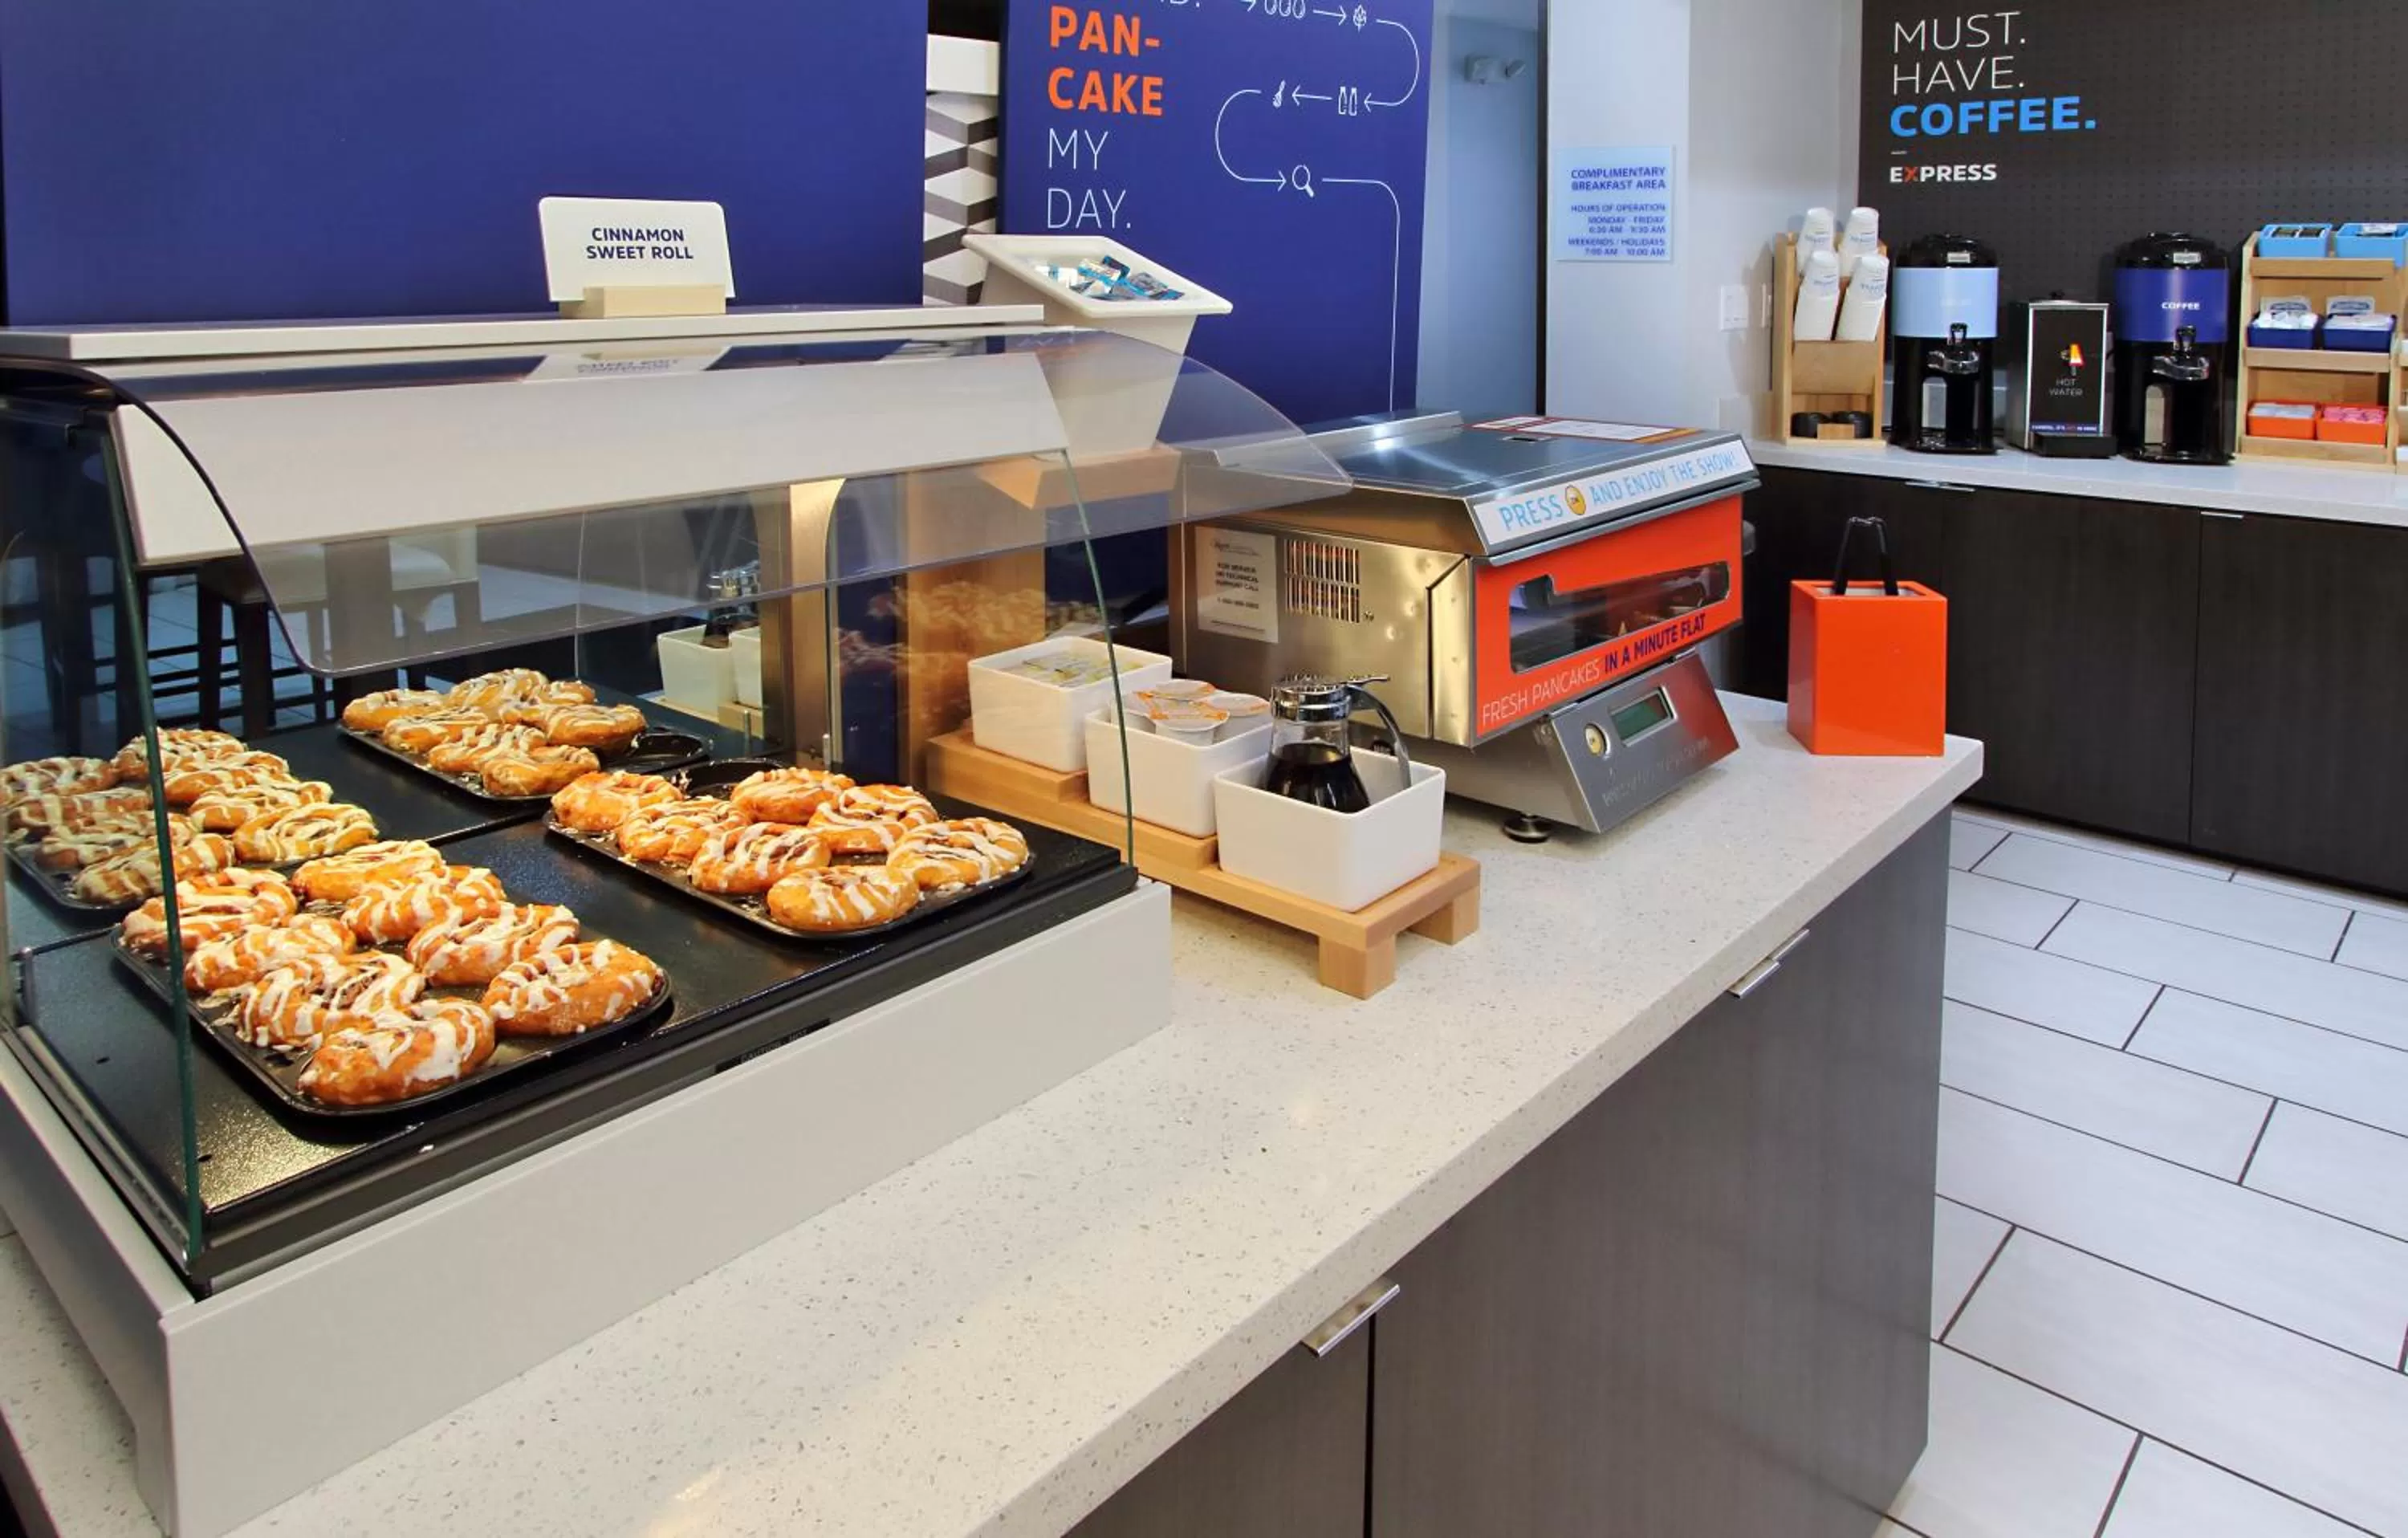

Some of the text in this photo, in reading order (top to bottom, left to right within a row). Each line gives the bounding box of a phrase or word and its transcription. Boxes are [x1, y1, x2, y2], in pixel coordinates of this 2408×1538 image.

[1049, 6, 1161, 57] PAN-
[1893, 10, 2026, 54] MUST.
[1893, 55, 2025, 96] HAVE.
[1047, 67, 1164, 117] CAKE
[1889, 96, 2097, 138] COFFEE.
[1047, 128, 1108, 169] MY
[1571, 166, 1666, 179] COMPLIMENTARY
[1889, 163, 1998, 183] EXPRESS
[1571, 179, 1666, 191] BREAKFAST AREA
[1047, 189, 1133, 230] DAY.
[1571, 203, 1666, 213] HOURS OF OPERATION
[1588, 216, 1625, 224] MONDAY
[1633, 215, 1665, 224] FRIDAY
[592, 227, 685, 242] CINNAMON
[587, 245, 694, 259] SWEET ROLL
[2161, 300, 2201, 310] COFFEE
[2056, 377, 2076, 387] HOT
[2048, 388, 2084, 397] WATER
[1499, 494, 1564, 532] PRESS
[1588, 480, 1622, 505] AND
[1625, 466, 1667, 498] ENJOY
[1669, 460, 1699, 482] THE
[1696, 450, 1739, 478] SHOW!
[1482, 612, 1706, 726] FRESH PANCAKES IN A MINUTE FLAT
